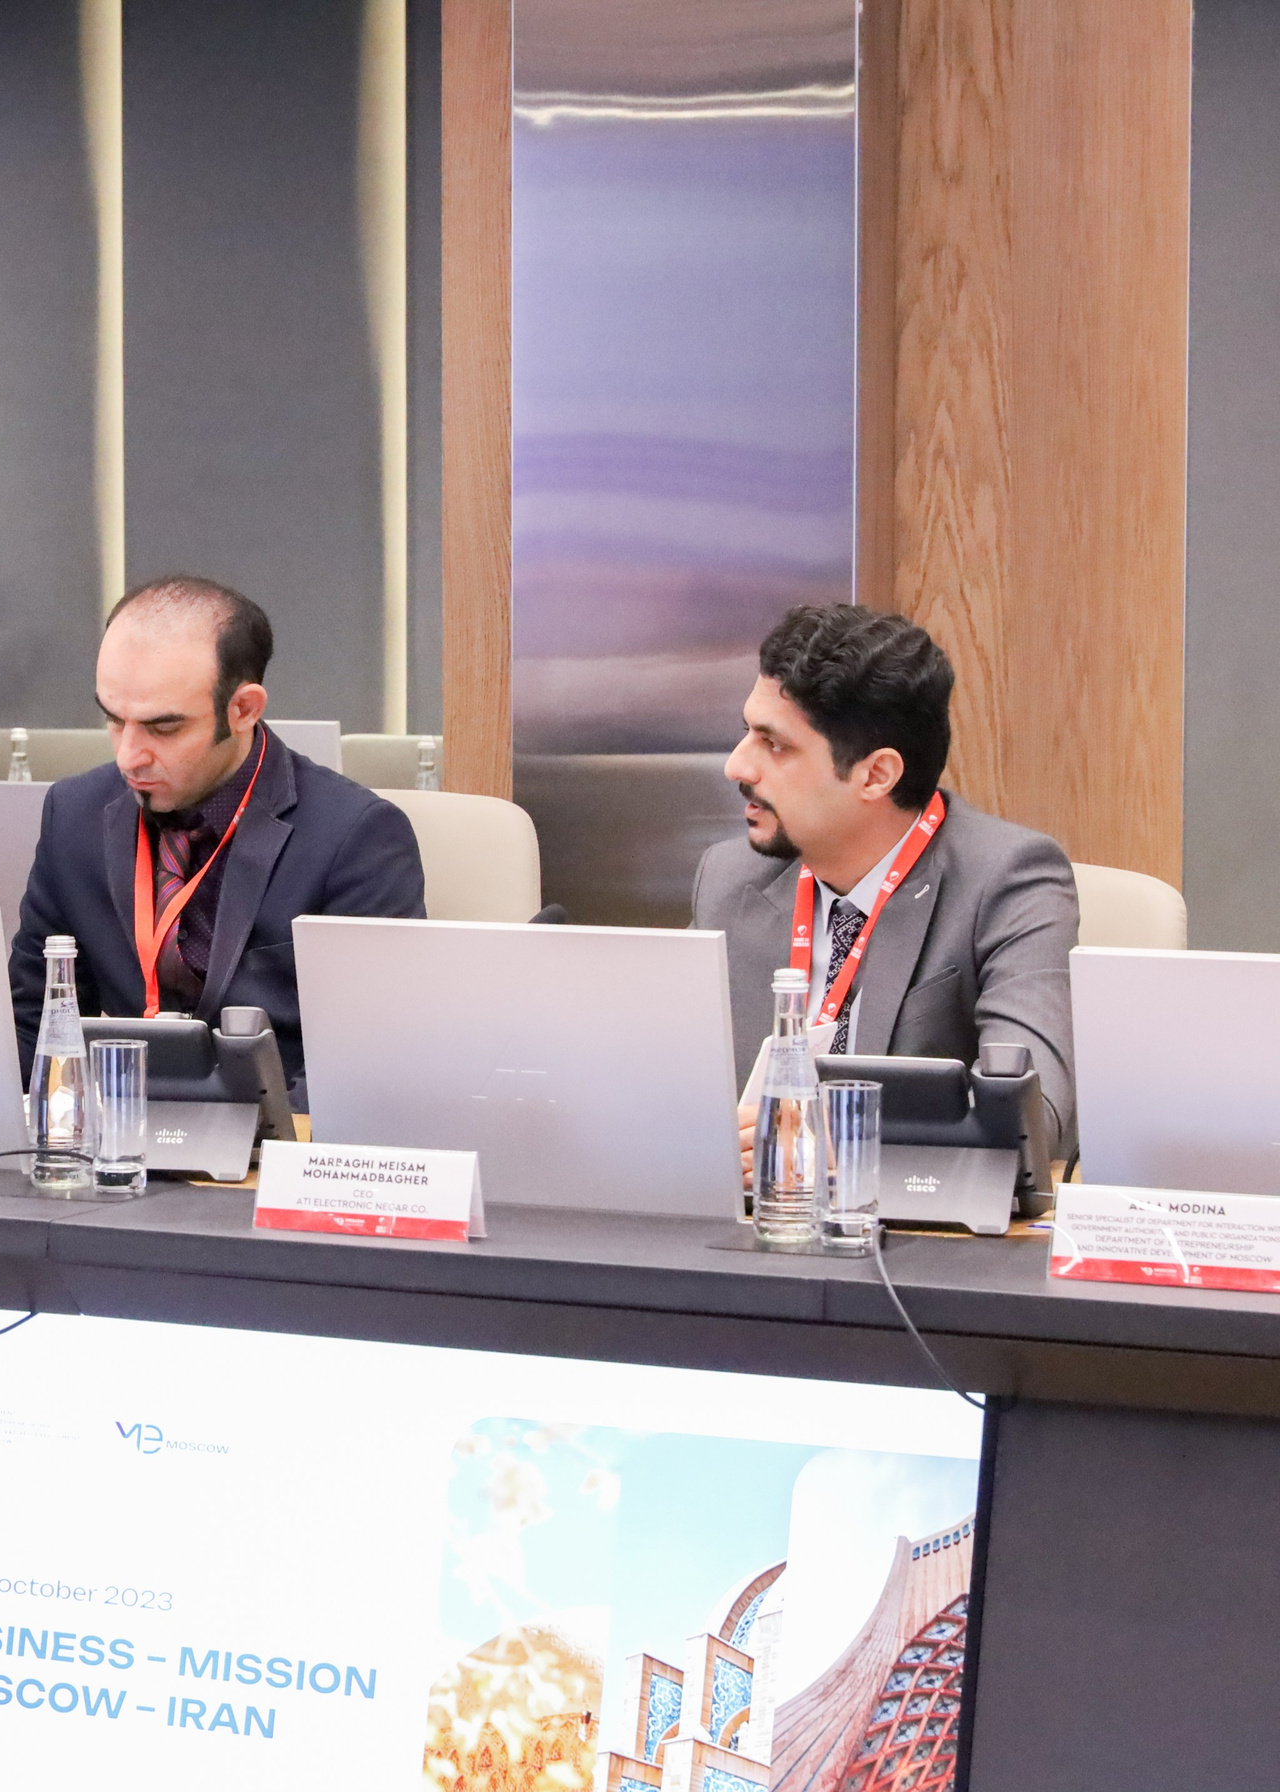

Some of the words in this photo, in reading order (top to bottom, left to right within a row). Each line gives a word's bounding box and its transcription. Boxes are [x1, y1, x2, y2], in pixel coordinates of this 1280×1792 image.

[309, 1156, 373, 1168] MARBAGHI
[378, 1160, 425, 1172] MEISAM
[302, 1168, 428, 1185] MOHAMMADBAGHER
[352, 1189, 373, 1198] CEO
[296, 1197, 310, 1205] ATI
[313, 1198, 372, 1209] ELECTRONIC
[410, 1204, 427, 1213] CO.
[1169, 1202, 1226, 1216] MODINA
[1067, 1213, 1092, 1221] SENIOR
[1095, 1214, 1133, 1223] SPECIALIST
[1148, 1218, 1196, 1227] DEPARTMENT
[1215, 1222, 1264, 1232] INTERACTION
[1071, 1223, 1121, 1232] GOVERNMENT
[1175, 1229, 1189, 1237] AND
[1191, 1230, 1217, 1238] PUBLIC
[1095, 1234, 1151, 1245] DEPARTMENT
[1153, 1238, 1165, 1246] OF
[1096, 1245, 1146, 1255] INNOVATIVE
[1229, 1253, 1272, 1263] MOSCOW
[166, 1439, 230, 1456] MOSCOW
[104, 1585, 173, 1612] 2023
[178, 1645, 376, 1699] MISSION
[167, 1696, 276, 1739] IRAN
